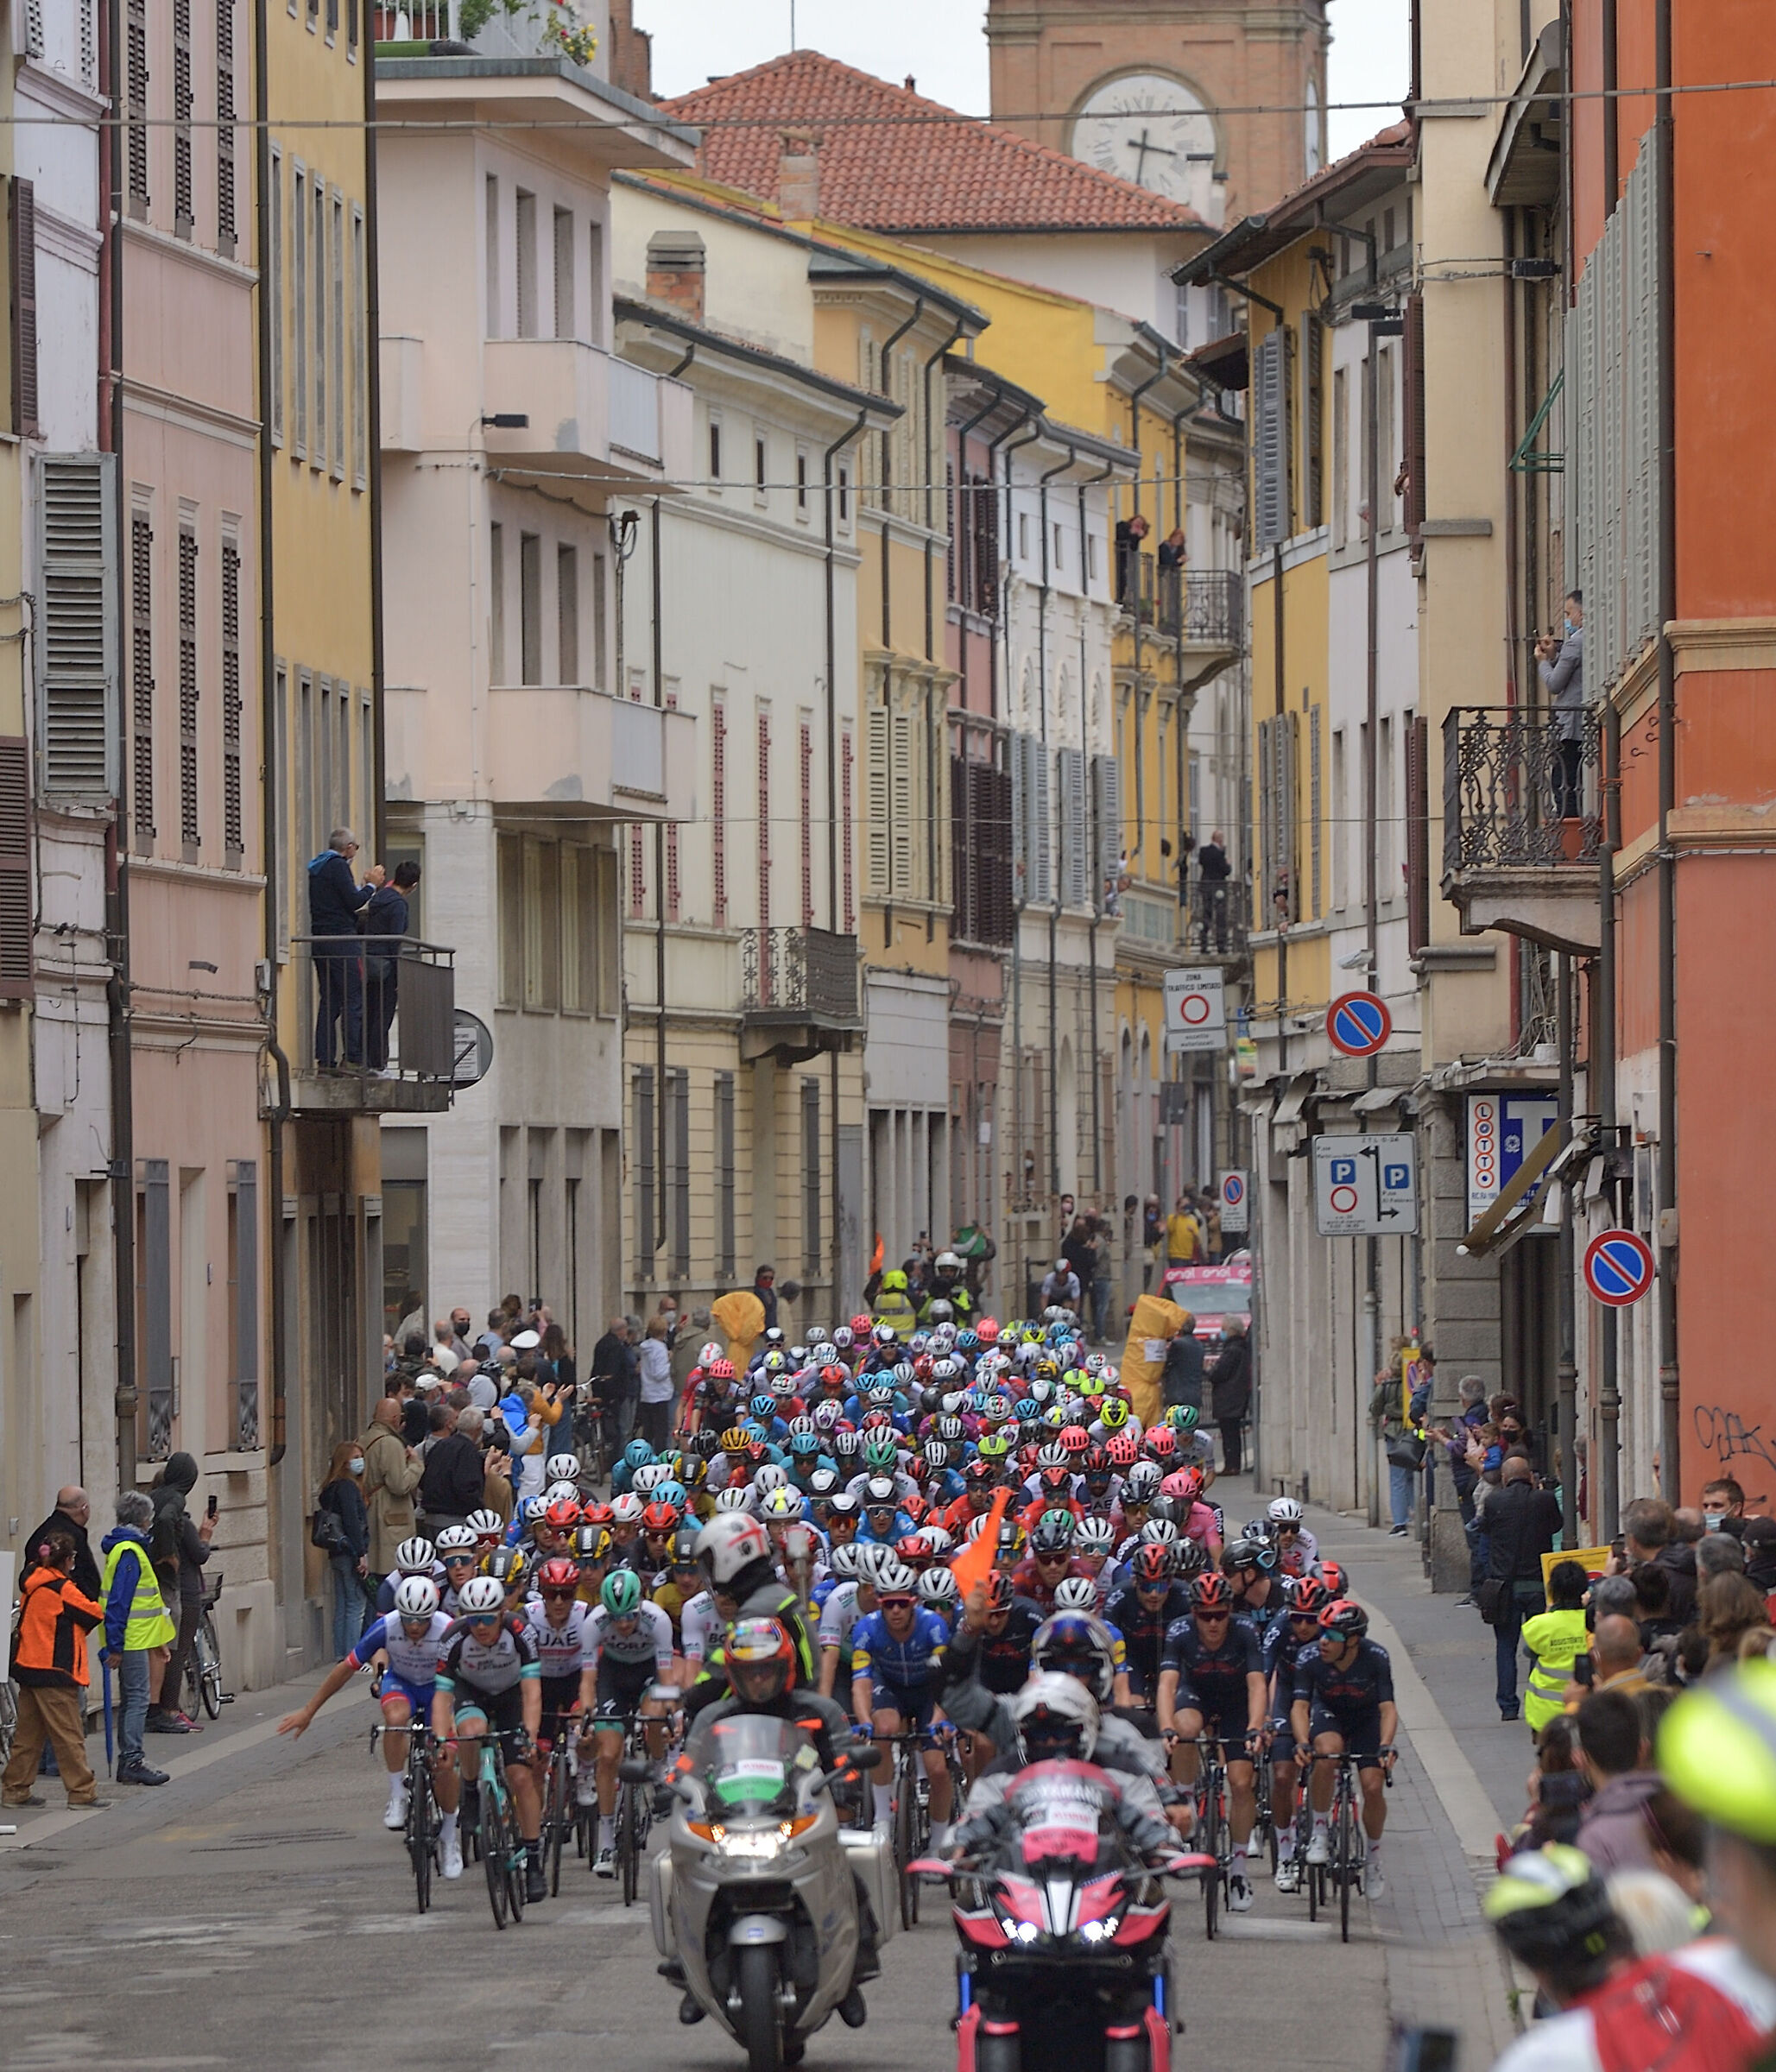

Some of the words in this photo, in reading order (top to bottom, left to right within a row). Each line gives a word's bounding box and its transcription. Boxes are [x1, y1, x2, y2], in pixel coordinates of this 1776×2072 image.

[1476, 1103, 1493, 1187] LOTTO
[1337, 1163, 1352, 1182] P
[1390, 1167, 1406, 1187] P
[538, 1631, 578, 1647] UAE
